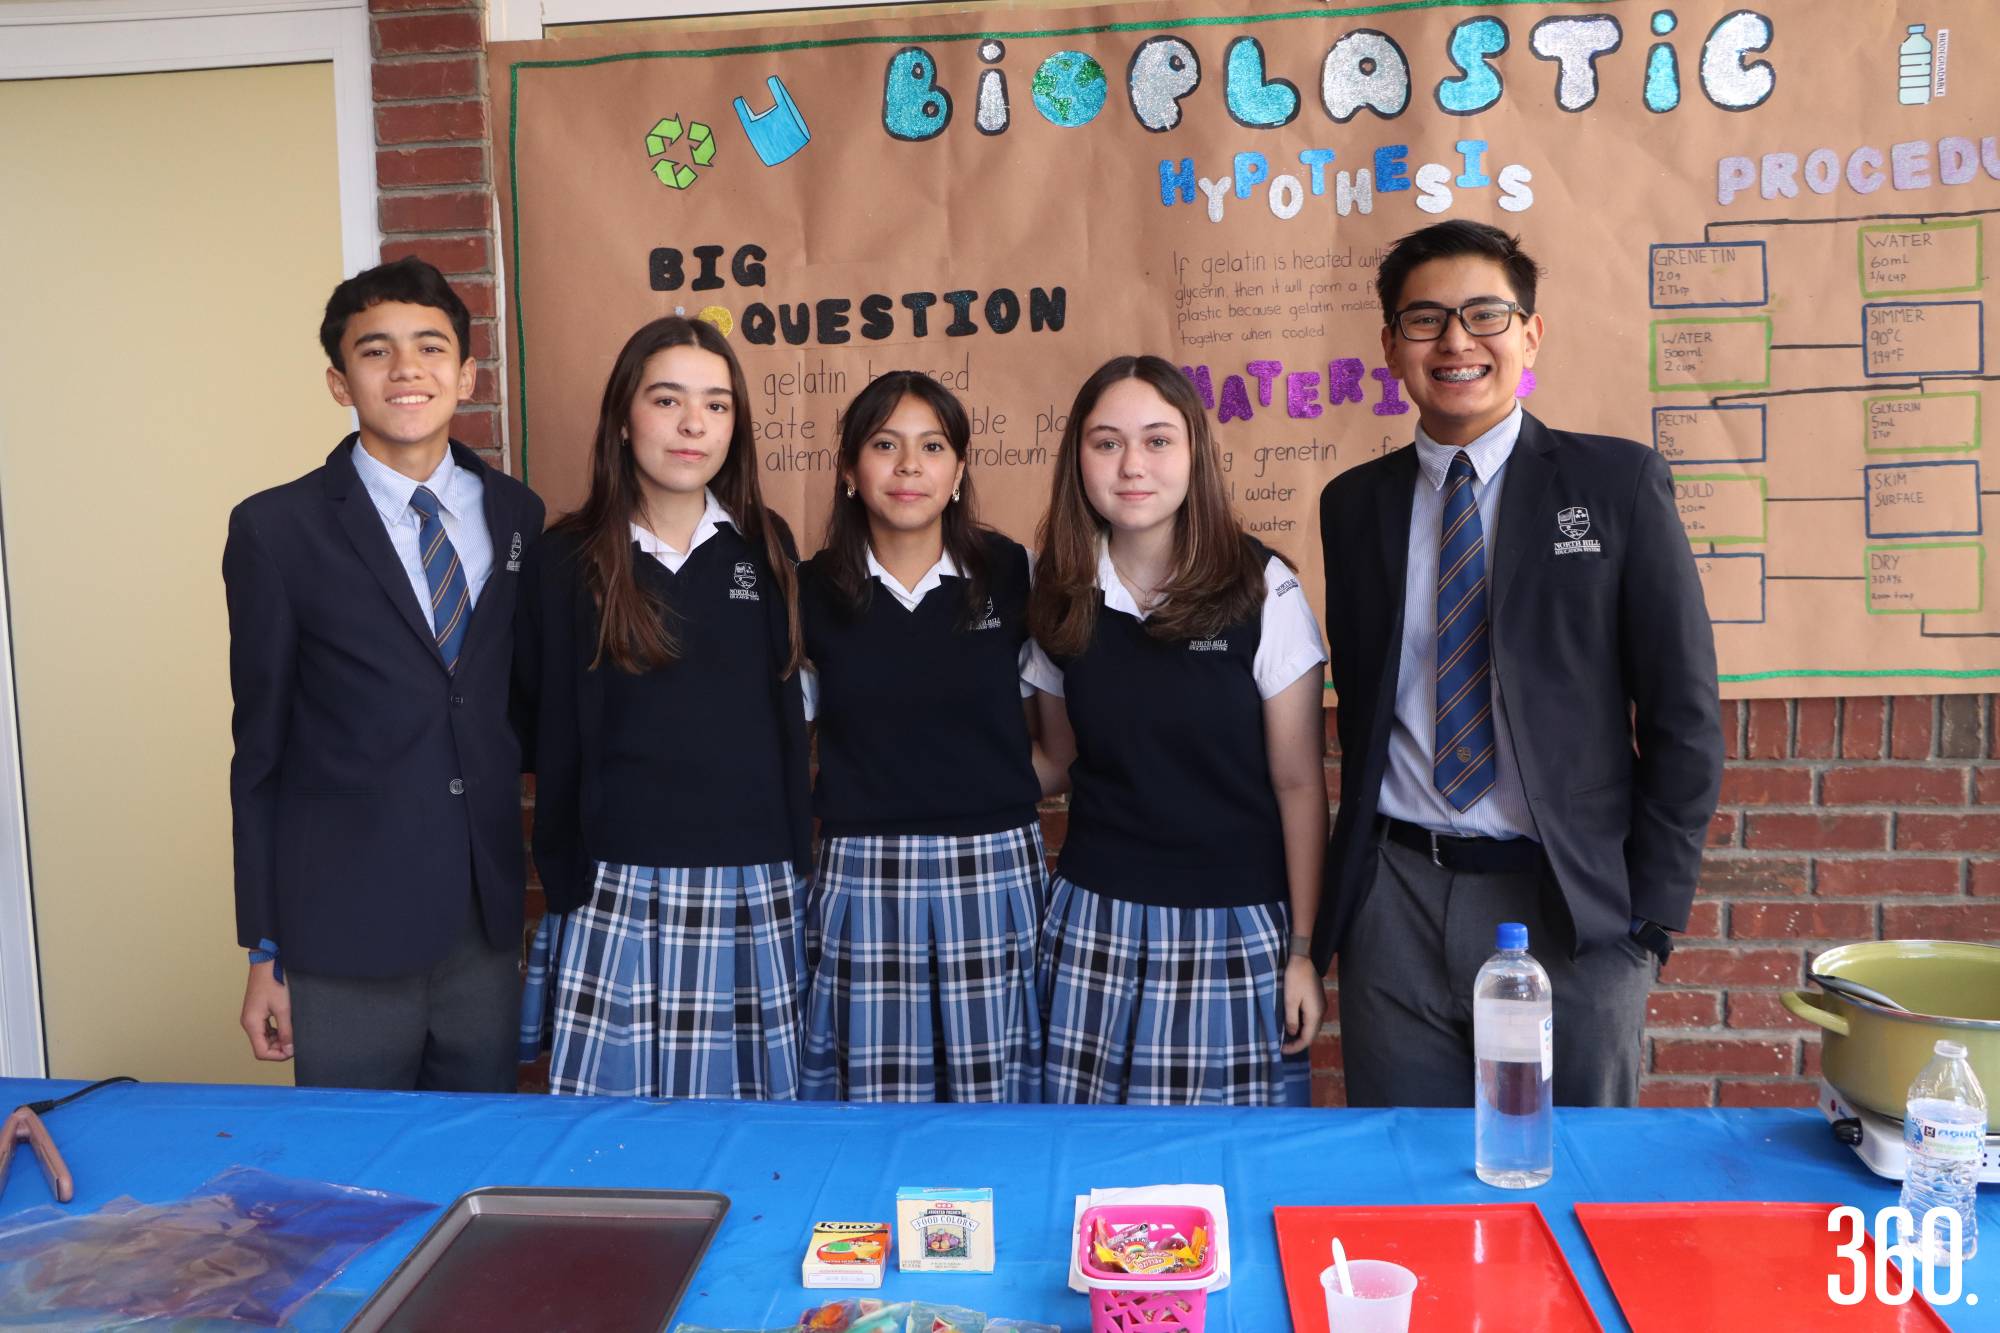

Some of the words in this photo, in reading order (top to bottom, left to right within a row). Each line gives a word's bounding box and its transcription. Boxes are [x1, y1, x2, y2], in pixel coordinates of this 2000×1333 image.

[1158, 139, 1534, 223] HYPOTHESIS
[1864, 232, 1934, 249] WATER
[1653, 248, 1737, 266] GRENETIN
[649, 244, 768, 292] BIG
[1201, 251, 1266, 288] gelatin
[1274, 255, 1287, 271] is
[1292, 246, 1353, 270] heated
[1234, 282, 1264, 298] then
[1271, 278, 1280, 294] it
[1284, 278, 1302, 293] will
[1309, 283, 1343, 300] form
[1348, 282, 1358, 292] a
[741, 286, 1067, 346] QUESTION
[1176, 306, 1223, 330] plastic
[1228, 303, 1282, 319] because
[1288, 302, 1334, 321] gelatin
[1869, 309, 1926, 325] SIMMER
[1180, 330, 1234, 349] together
[1241, 326, 1272, 341] when
[1282, 324, 1325, 340] cooled
[1661, 331, 1713, 344] WATER
[1664, 361, 1673, 372] 2
[763, 358, 847, 416] gelatin
[1870, 402, 1921, 415] GLYCERIN
[751, 405, 817, 441] eate
[1658, 413, 1698, 427] PECTIN
[765, 443, 841, 473] altern
[1254, 437, 1337, 478] grenetin
[1875, 473, 1907, 490] SKIM
[1245, 481, 1297, 502] water
[1674, 482, 1714, 500] OULD
[1875, 491, 1925, 508] SURFACE
[1250, 515, 1297, 533] water
[1554, 540, 1581, 551] NORTH
[1872, 553, 1900, 570] DRY
[916, 1215, 938, 1228] FOOD
[940, 1214, 975, 1229] COLORS
